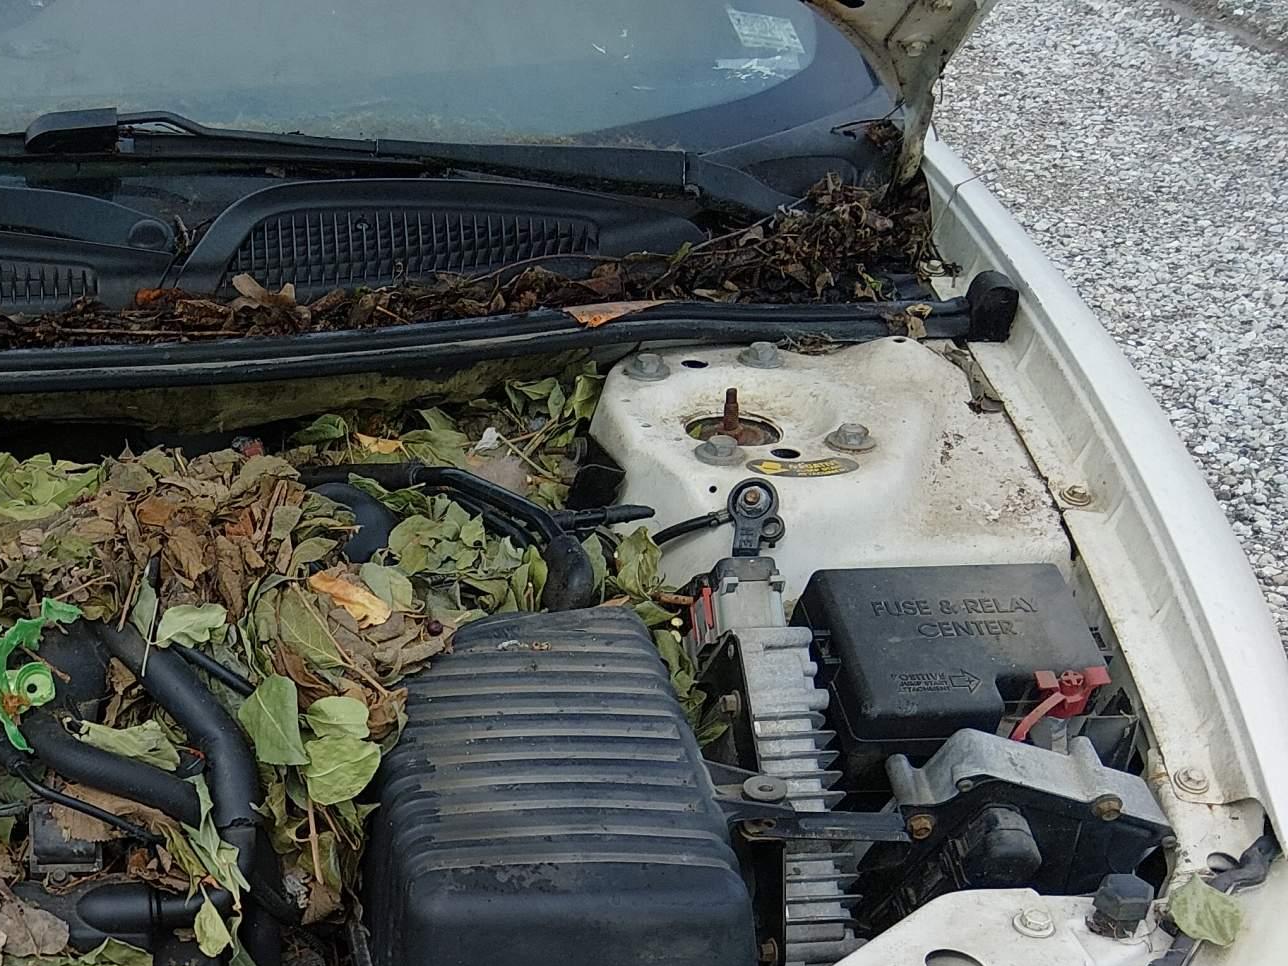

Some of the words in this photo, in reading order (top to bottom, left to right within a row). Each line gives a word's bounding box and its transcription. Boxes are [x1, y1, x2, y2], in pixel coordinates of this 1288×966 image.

[871, 600, 932, 616] FUSE
[939, 600, 958, 615] &
[963, 597, 1038, 614] RELAY
[917, 620, 1017, 637] CENTER
